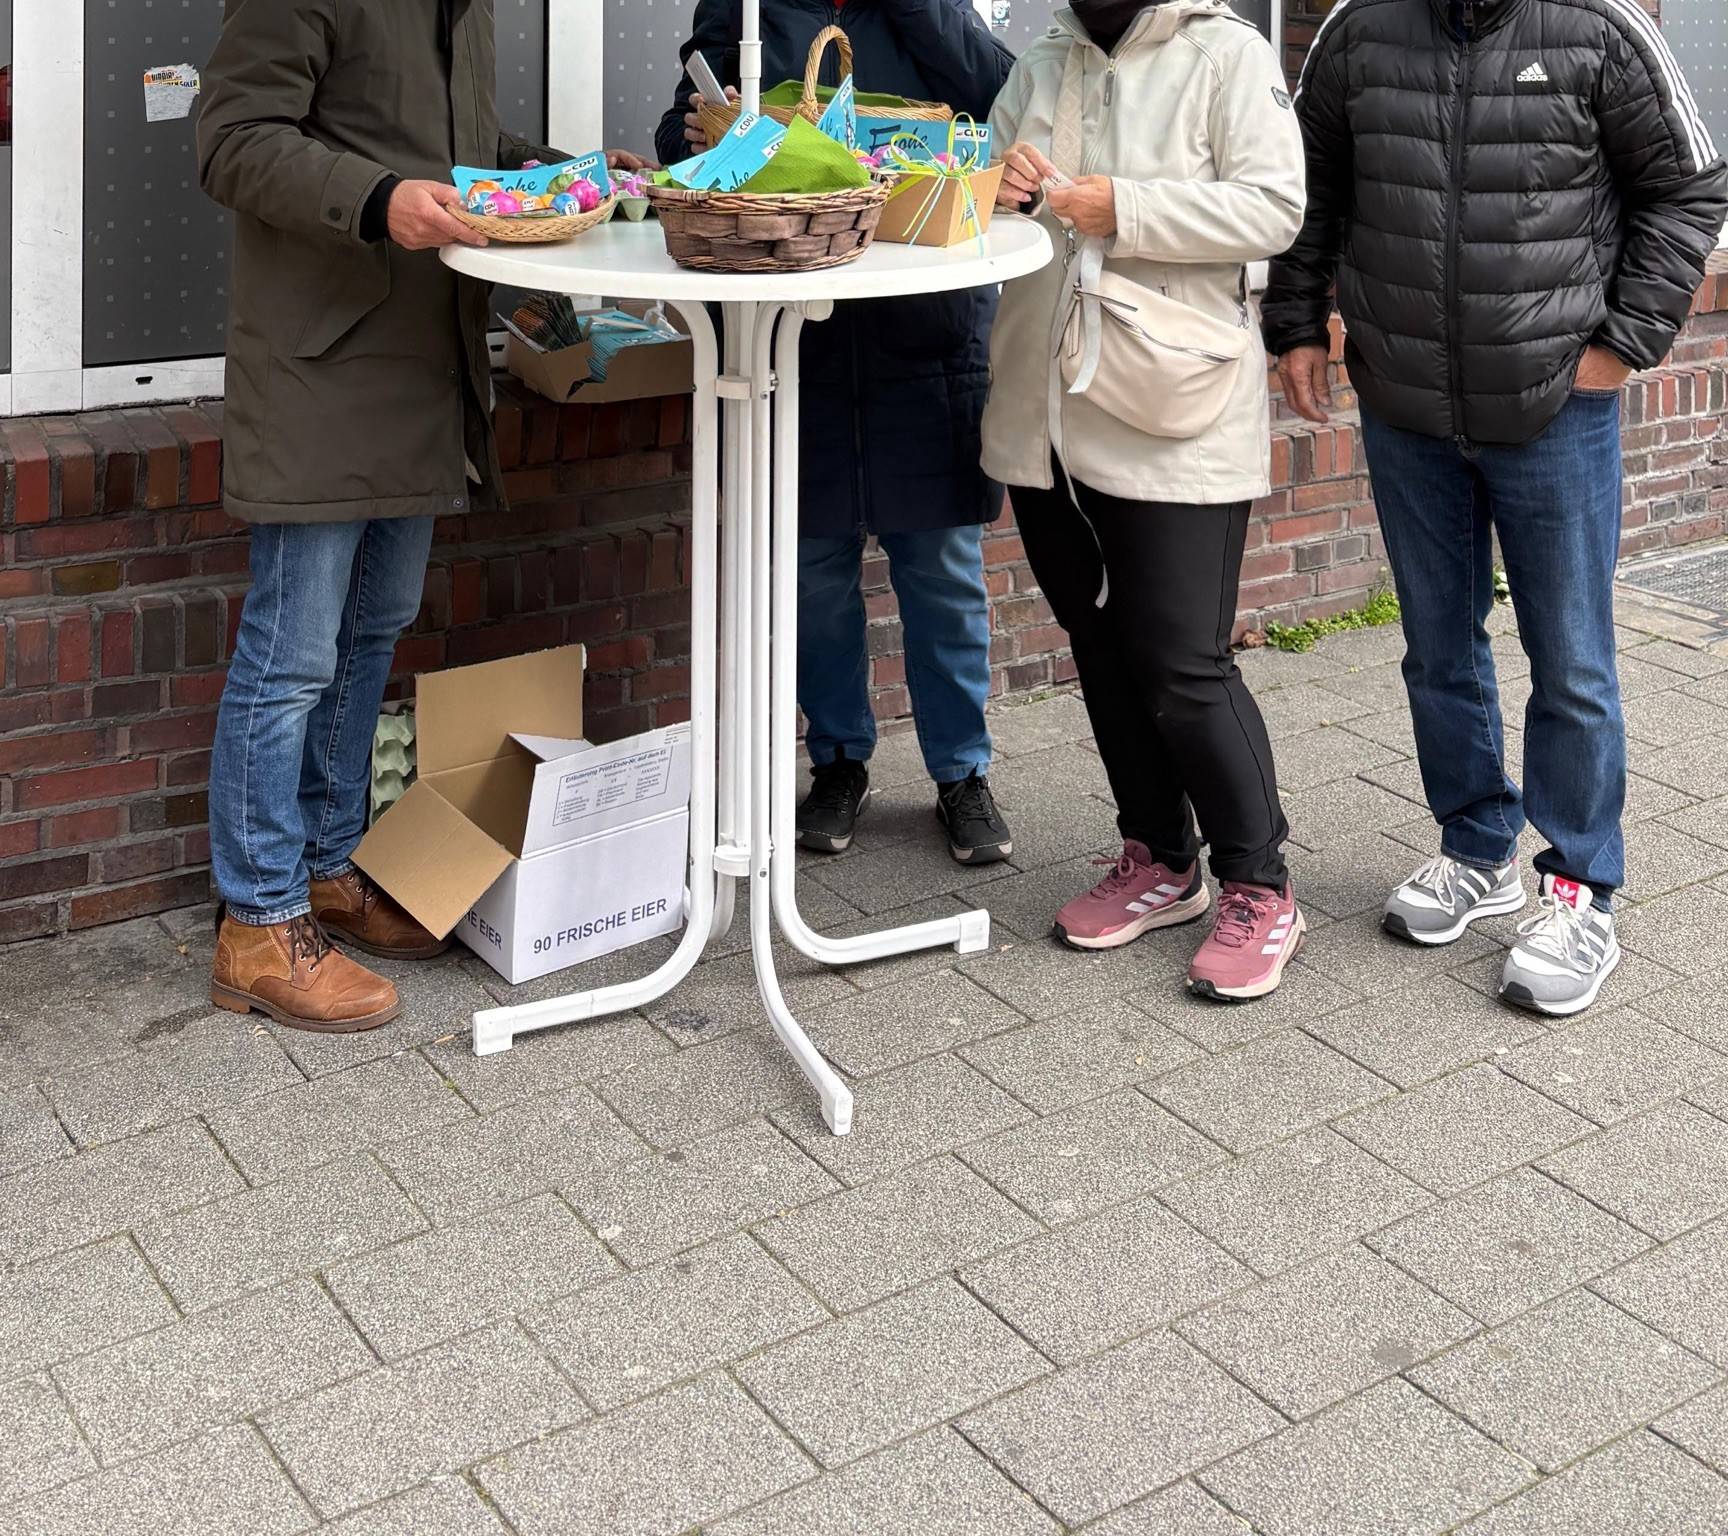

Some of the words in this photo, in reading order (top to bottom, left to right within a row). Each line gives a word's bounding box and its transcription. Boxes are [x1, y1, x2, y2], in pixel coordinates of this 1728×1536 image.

[1516, 74, 1548, 82] adidas
[740, 115, 754, 131] CDU
[771, 141, 783, 152] CD
[869, 124, 928, 157] Fohe
[572, 158, 595, 170] CDU
[533, 936, 551, 954] 90
[556, 911, 627, 947] FRISCHE
[631, 898, 668, 923] EIER
[479, 918, 502, 951] EIER
